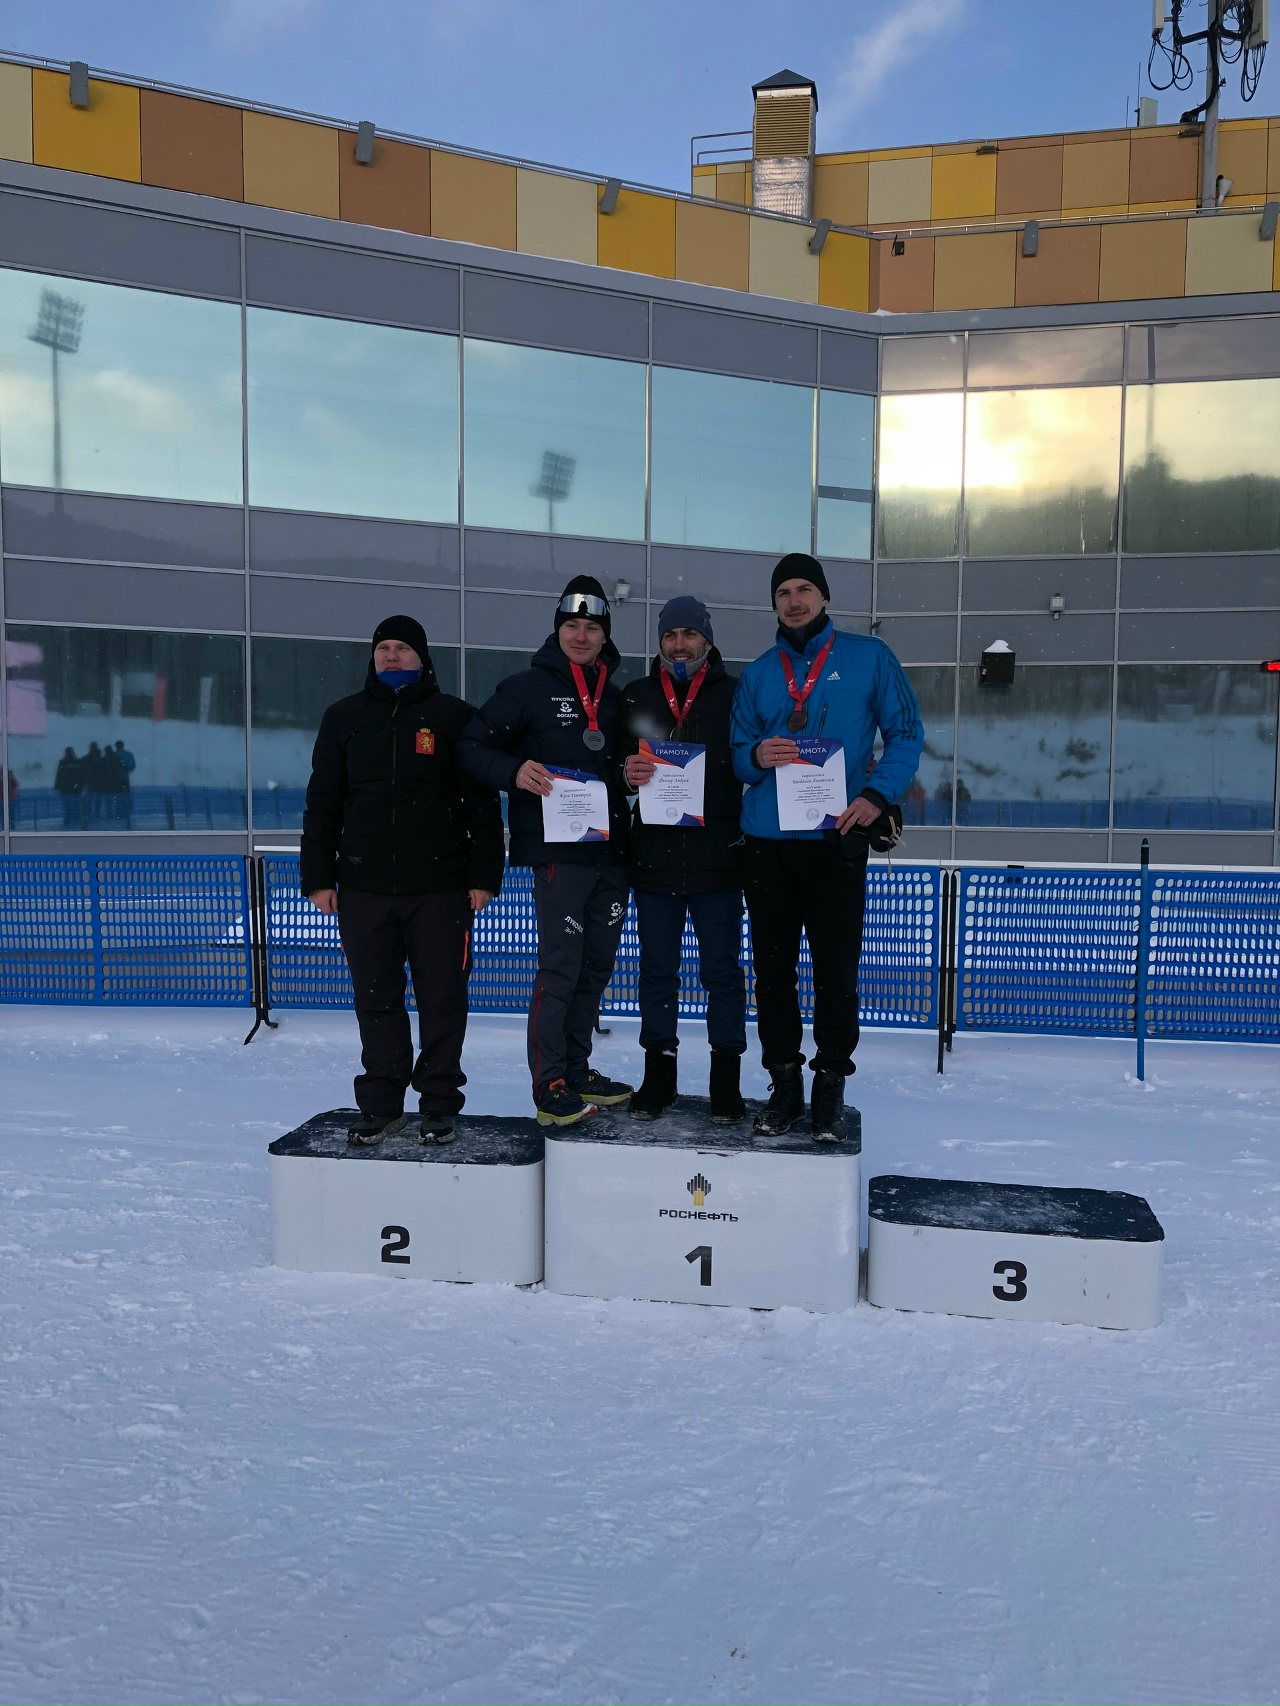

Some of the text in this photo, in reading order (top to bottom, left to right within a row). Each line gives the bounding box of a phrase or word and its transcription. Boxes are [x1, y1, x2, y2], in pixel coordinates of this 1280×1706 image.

[655, 748, 690, 756] ГРАМОТА
[799, 747, 827, 755] АМОТА
[659, 1208, 739, 1223] РОСНЕФТЬ
[380, 1225, 411, 1265] 2
[684, 1245, 712, 1287] 1
[992, 1260, 1028, 1302] 3
